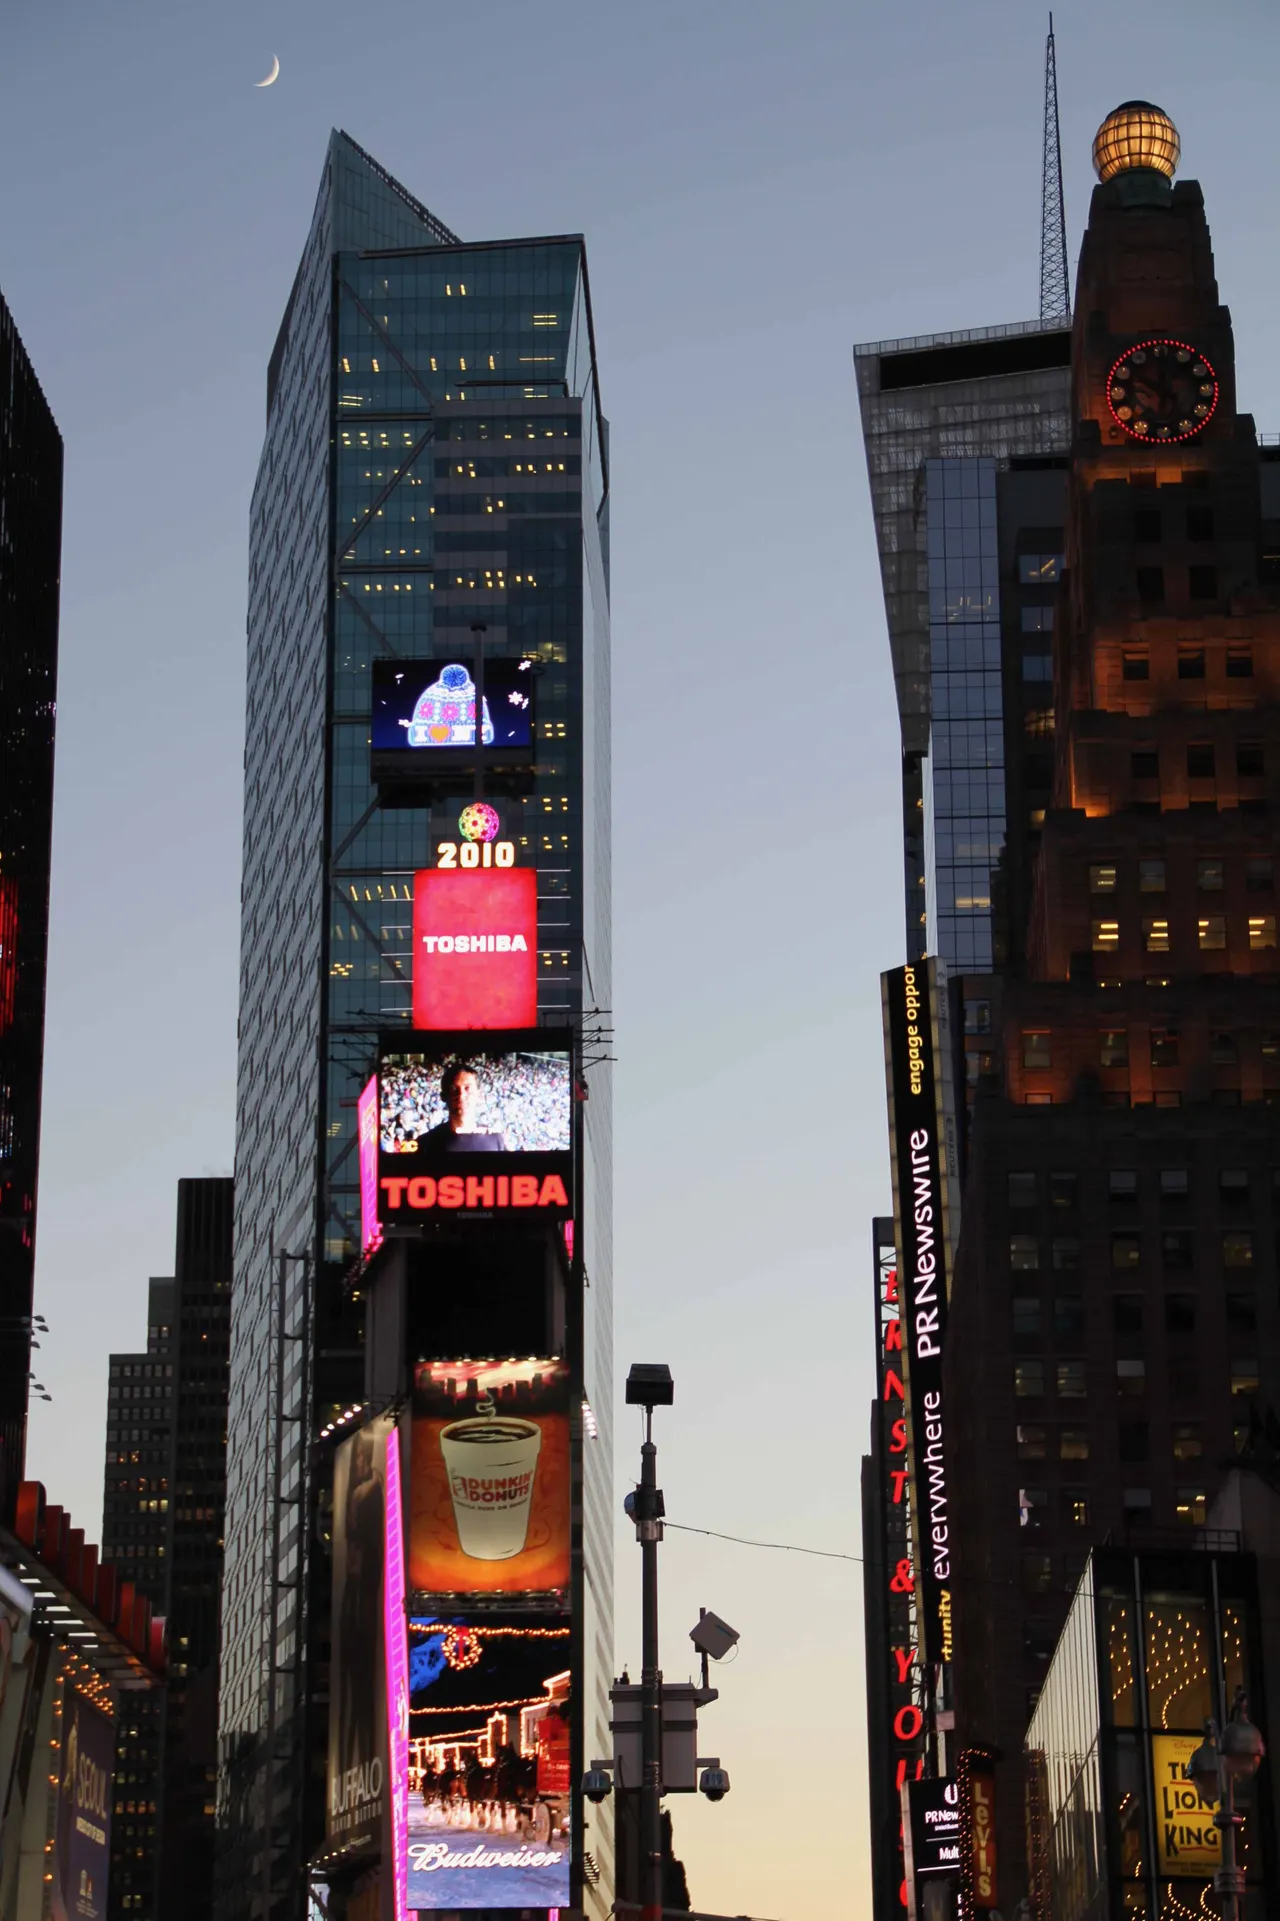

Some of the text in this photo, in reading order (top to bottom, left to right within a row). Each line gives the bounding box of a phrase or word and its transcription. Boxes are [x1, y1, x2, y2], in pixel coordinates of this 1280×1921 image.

[437, 842, 515, 869] 2010
[422, 934, 528, 954] TOSHIBA
[907, 1025, 925, 1095] engage
[380, 1174, 569, 1209] TOSHIBA
[910, 1128, 941, 1359] PRNewswire
[469, 1484, 529, 1503] DONUTS
[923, 1391, 950, 1580] everywhere
[332, 1757, 383, 1816] BUFFALO
[893, 1648, 924, 1907] YOU
[406, 1842, 562, 1871] Budweiser
[1163, 1823, 1219, 1858] KING
